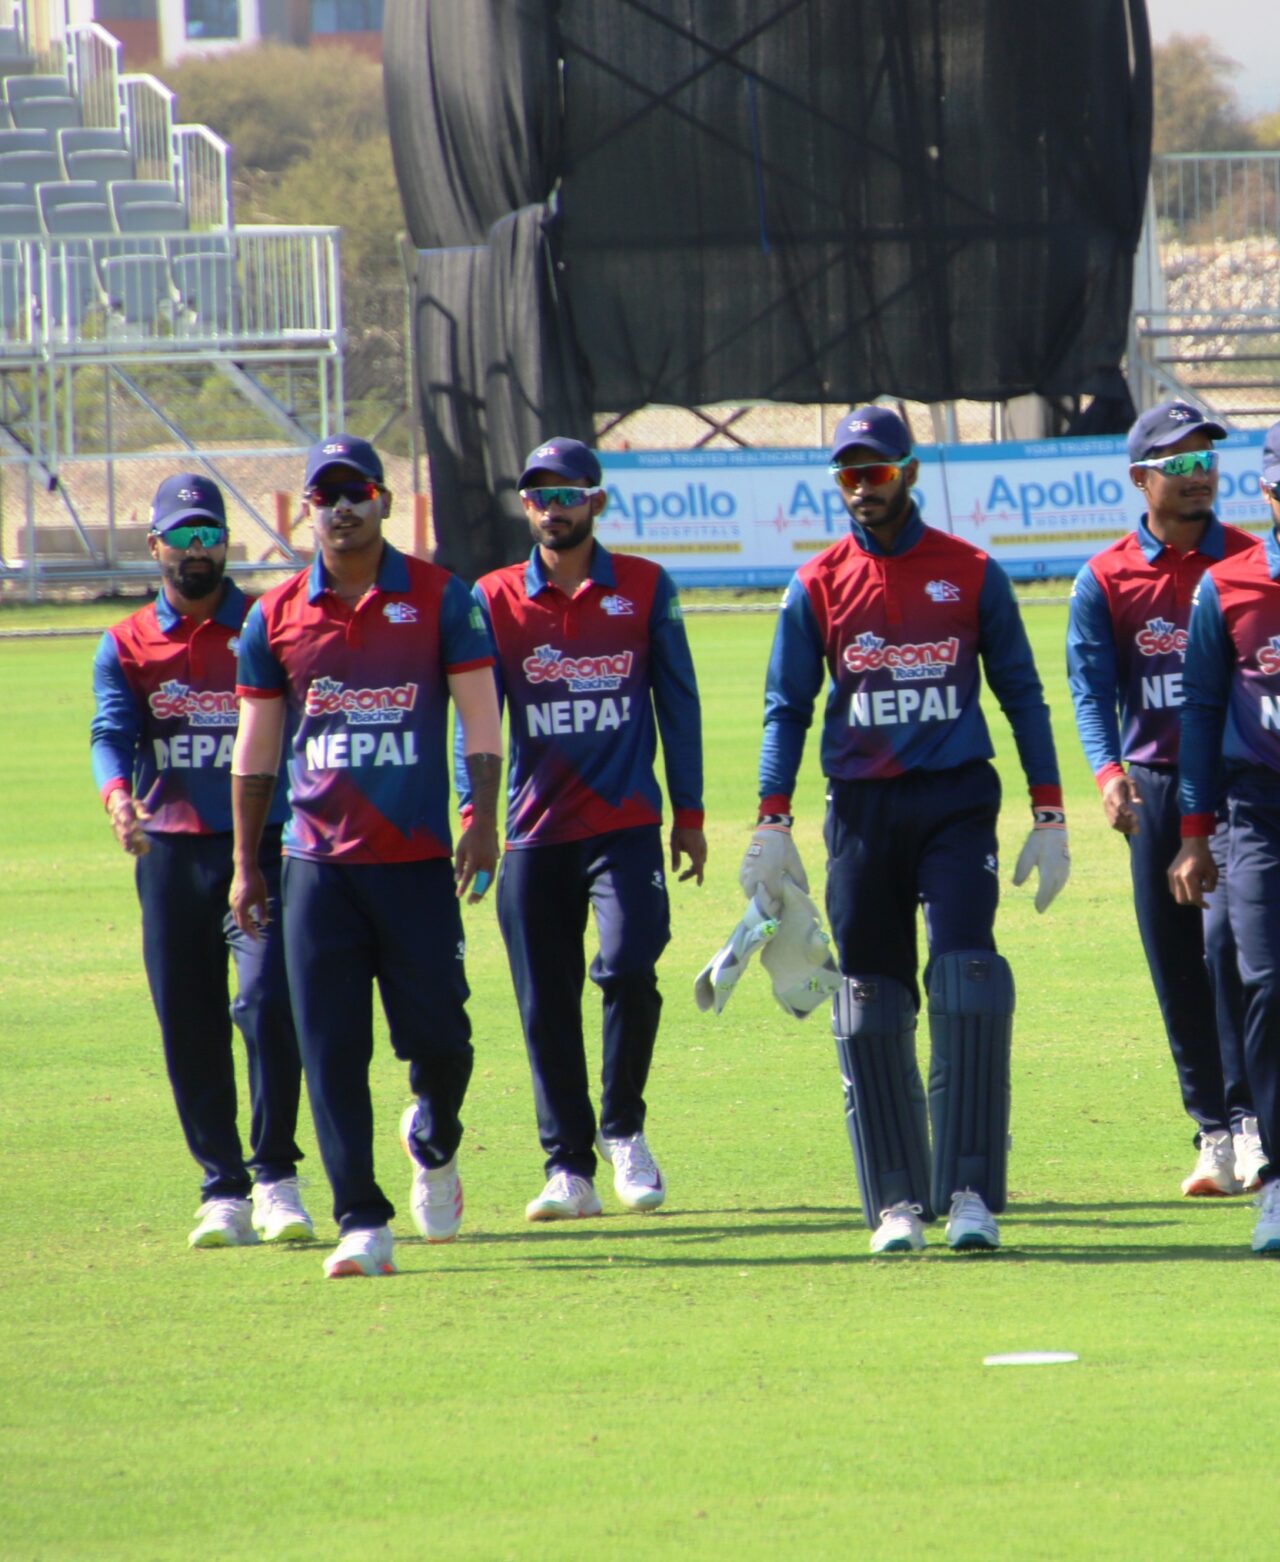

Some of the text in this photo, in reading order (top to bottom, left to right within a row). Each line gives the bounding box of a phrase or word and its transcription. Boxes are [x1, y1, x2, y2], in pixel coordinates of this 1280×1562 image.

[601, 481, 737, 537] Apollo
[986, 470, 1124, 527] Apollo
[1035, 511, 1127, 527] HOSPITALS
[1148, 618, 1173, 634] My
[857, 633, 883, 649] My
[1136, 629, 1189, 655] Sec
[535, 645, 561, 662] My
[845, 637, 958, 672] Second
[524, 652, 632, 683] Second
[893, 665, 946, 680] Teacher
[161, 681, 188, 698] My
[314, 676, 342, 693] My
[568, 678, 621, 691] Teacher
[307, 684, 417, 716] Second
[849, 685, 962, 727] NEPAL
[347, 710, 402, 724] Teacher
[152, 734, 235, 770] NEPA
[306, 731, 418, 770] NEPAL
